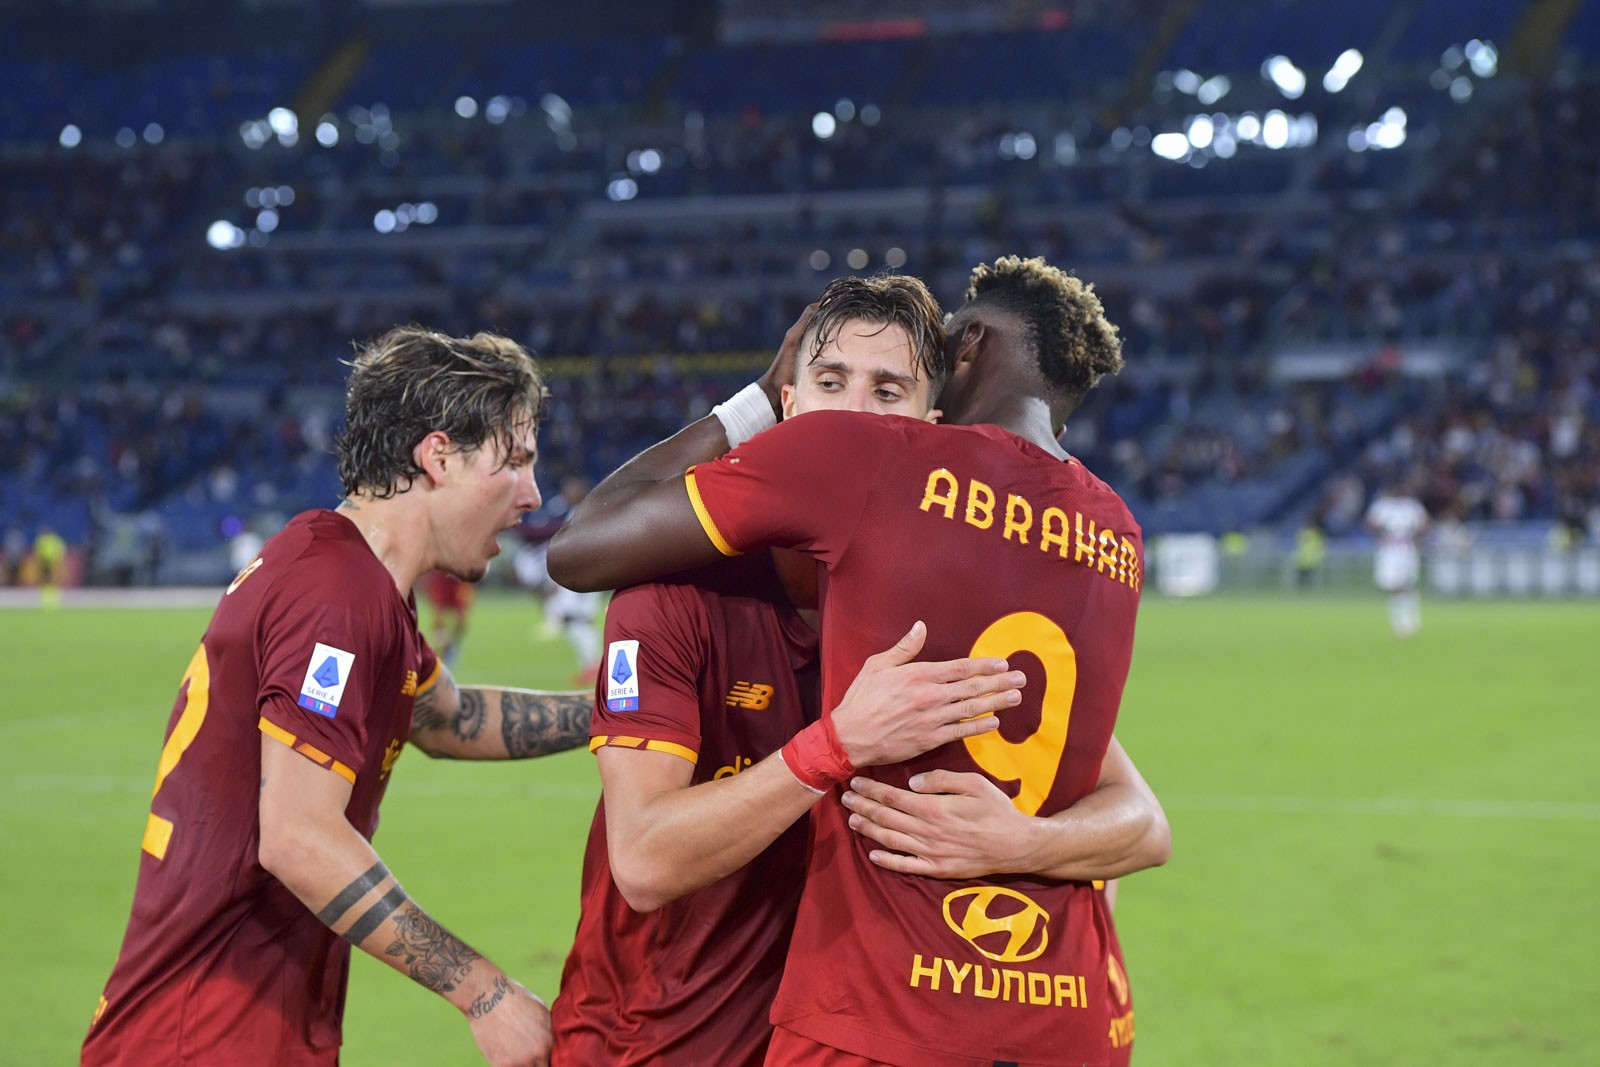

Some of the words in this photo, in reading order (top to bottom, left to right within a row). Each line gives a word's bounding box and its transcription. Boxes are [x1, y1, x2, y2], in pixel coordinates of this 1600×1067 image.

[919, 467, 1140, 593] ABRAHAM
[610, 687, 628, 697] SERIE
[959, 611, 1077, 818] 9
[909, 953, 1088, 1009] HYUNDAI
